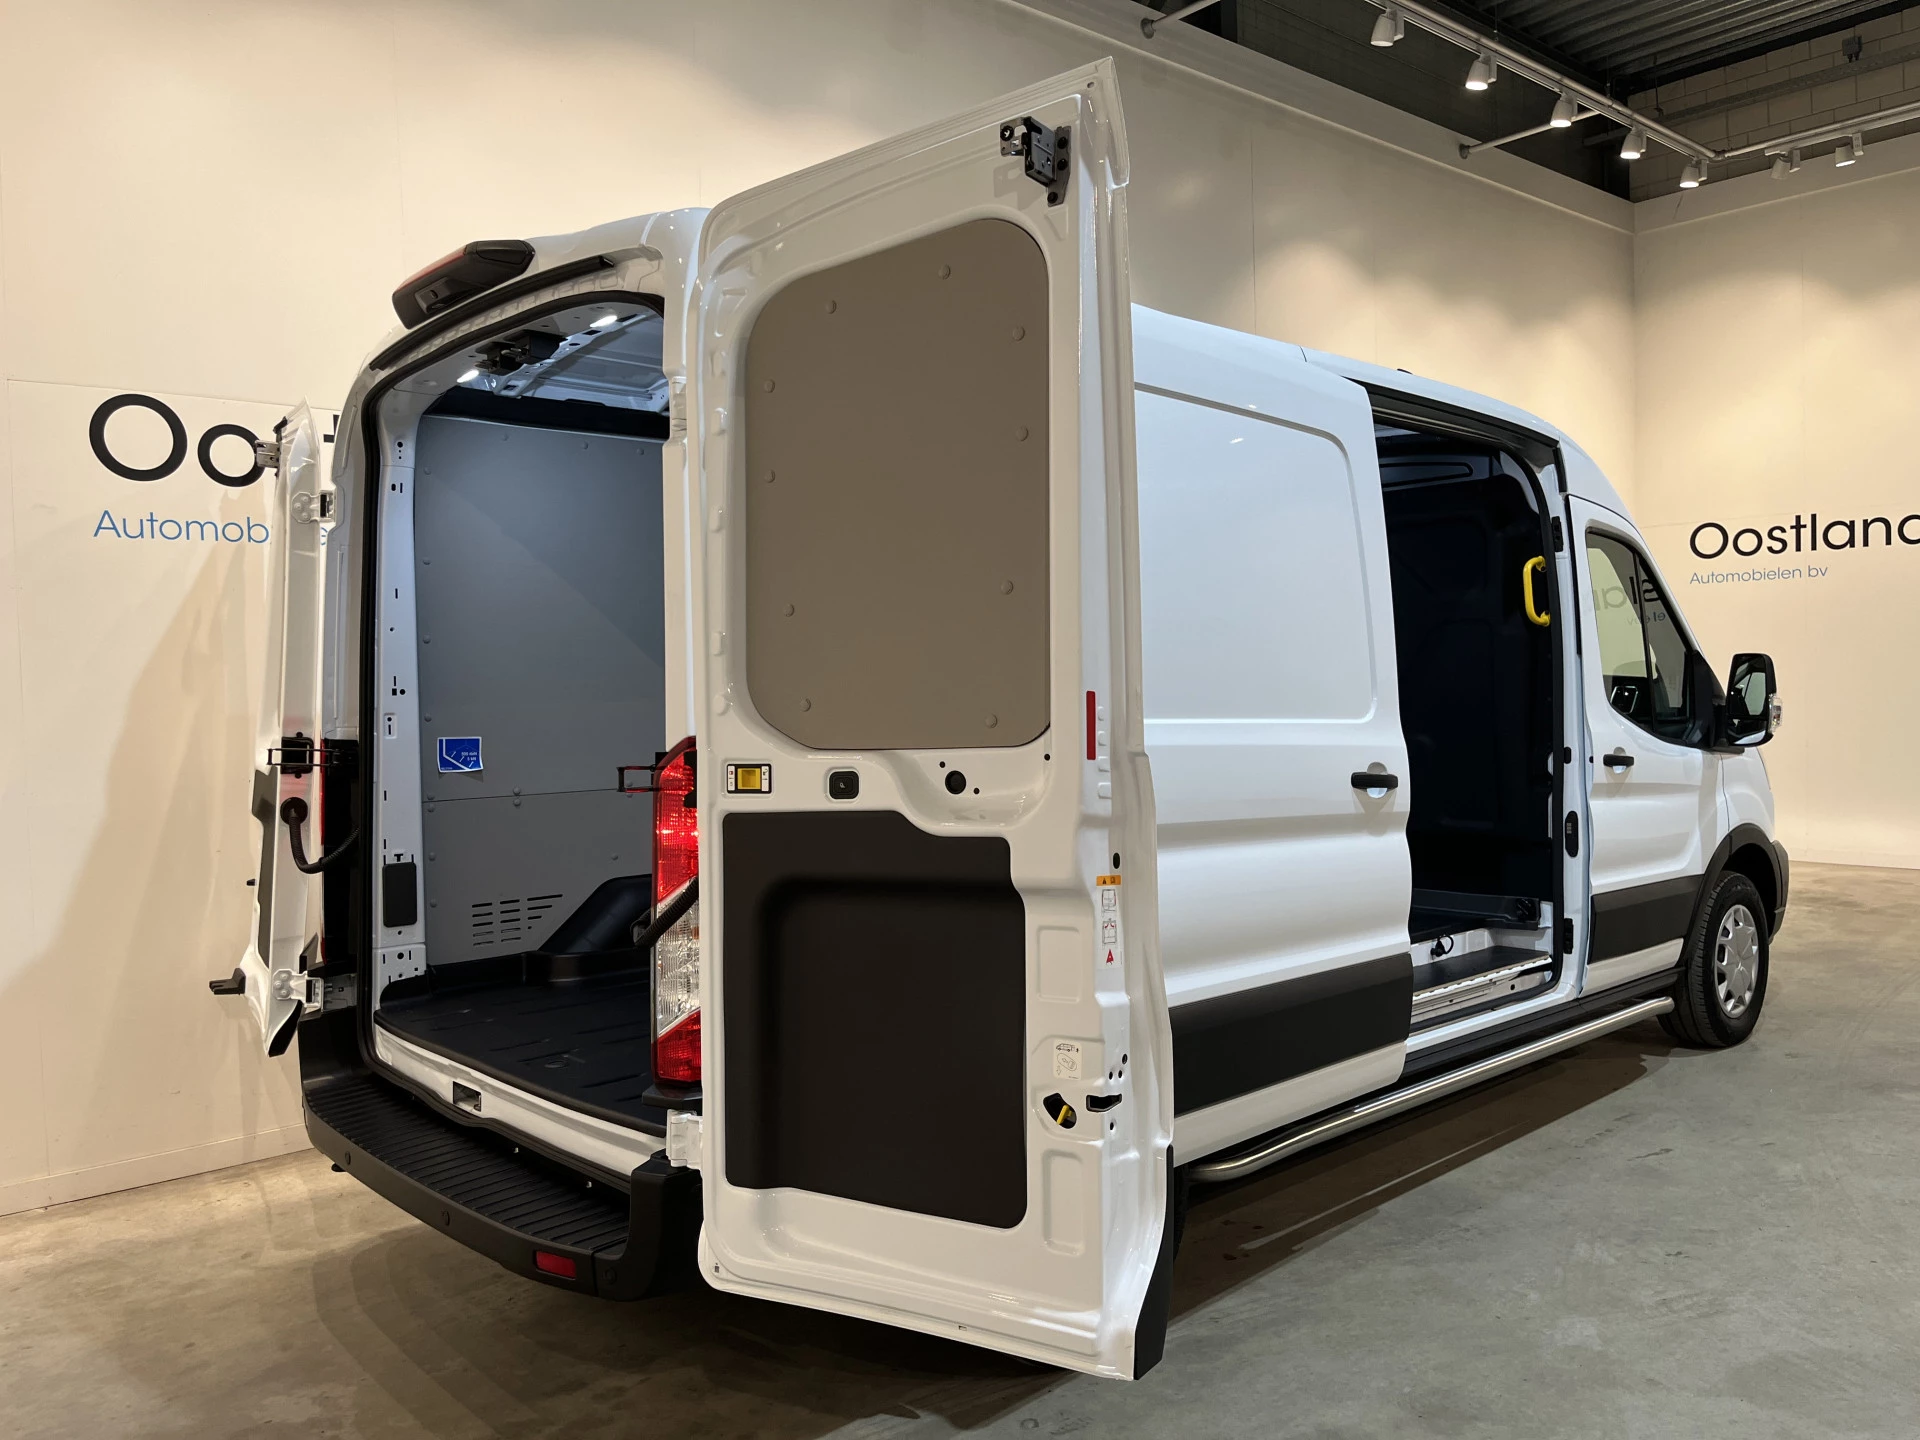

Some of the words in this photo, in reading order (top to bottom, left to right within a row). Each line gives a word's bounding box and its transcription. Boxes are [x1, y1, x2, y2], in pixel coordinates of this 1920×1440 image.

[89, 393, 340, 487] Oo
[93, 509, 328, 545] Automob
[1689, 567, 1802, 585] Automobielen
[1807, 565, 1828, 578] bv
